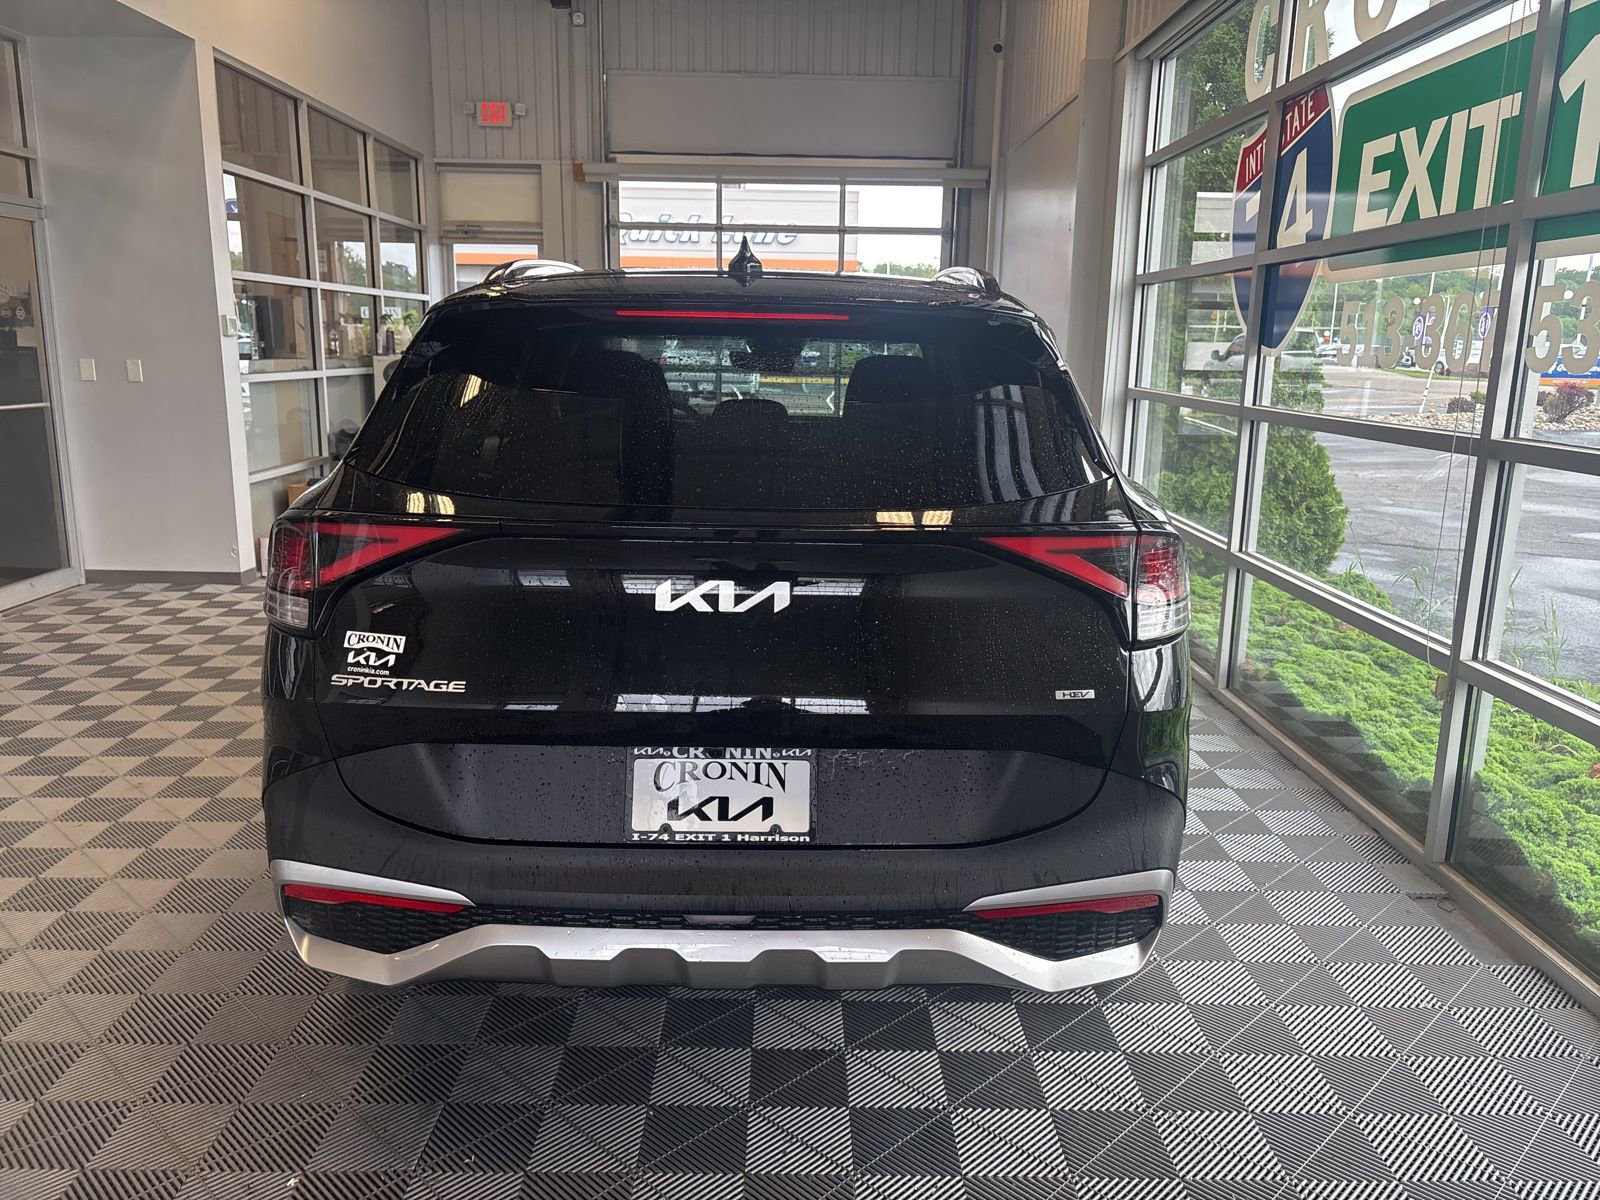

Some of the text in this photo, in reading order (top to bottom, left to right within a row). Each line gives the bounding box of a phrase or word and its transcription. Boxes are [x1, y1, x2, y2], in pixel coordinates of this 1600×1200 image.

[1353, 92, 1523, 232] EXIT
[655, 579, 791, 613] KIA
[347, 632, 404, 652] CRONIN
[347, 650, 396, 668] KIA
[347, 665, 390, 676] croninkia.com
[330, 673, 467, 693] SPORTAGE
[1062, 690, 1091, 699] HEV
[672, 746, 772, 760] CRNIN
[653, 760, 789, 794] CRONIN
[666, 795, 774, 822] KIA
[631, 833, 811, 843] I-74 EXIT 1 Harrison
